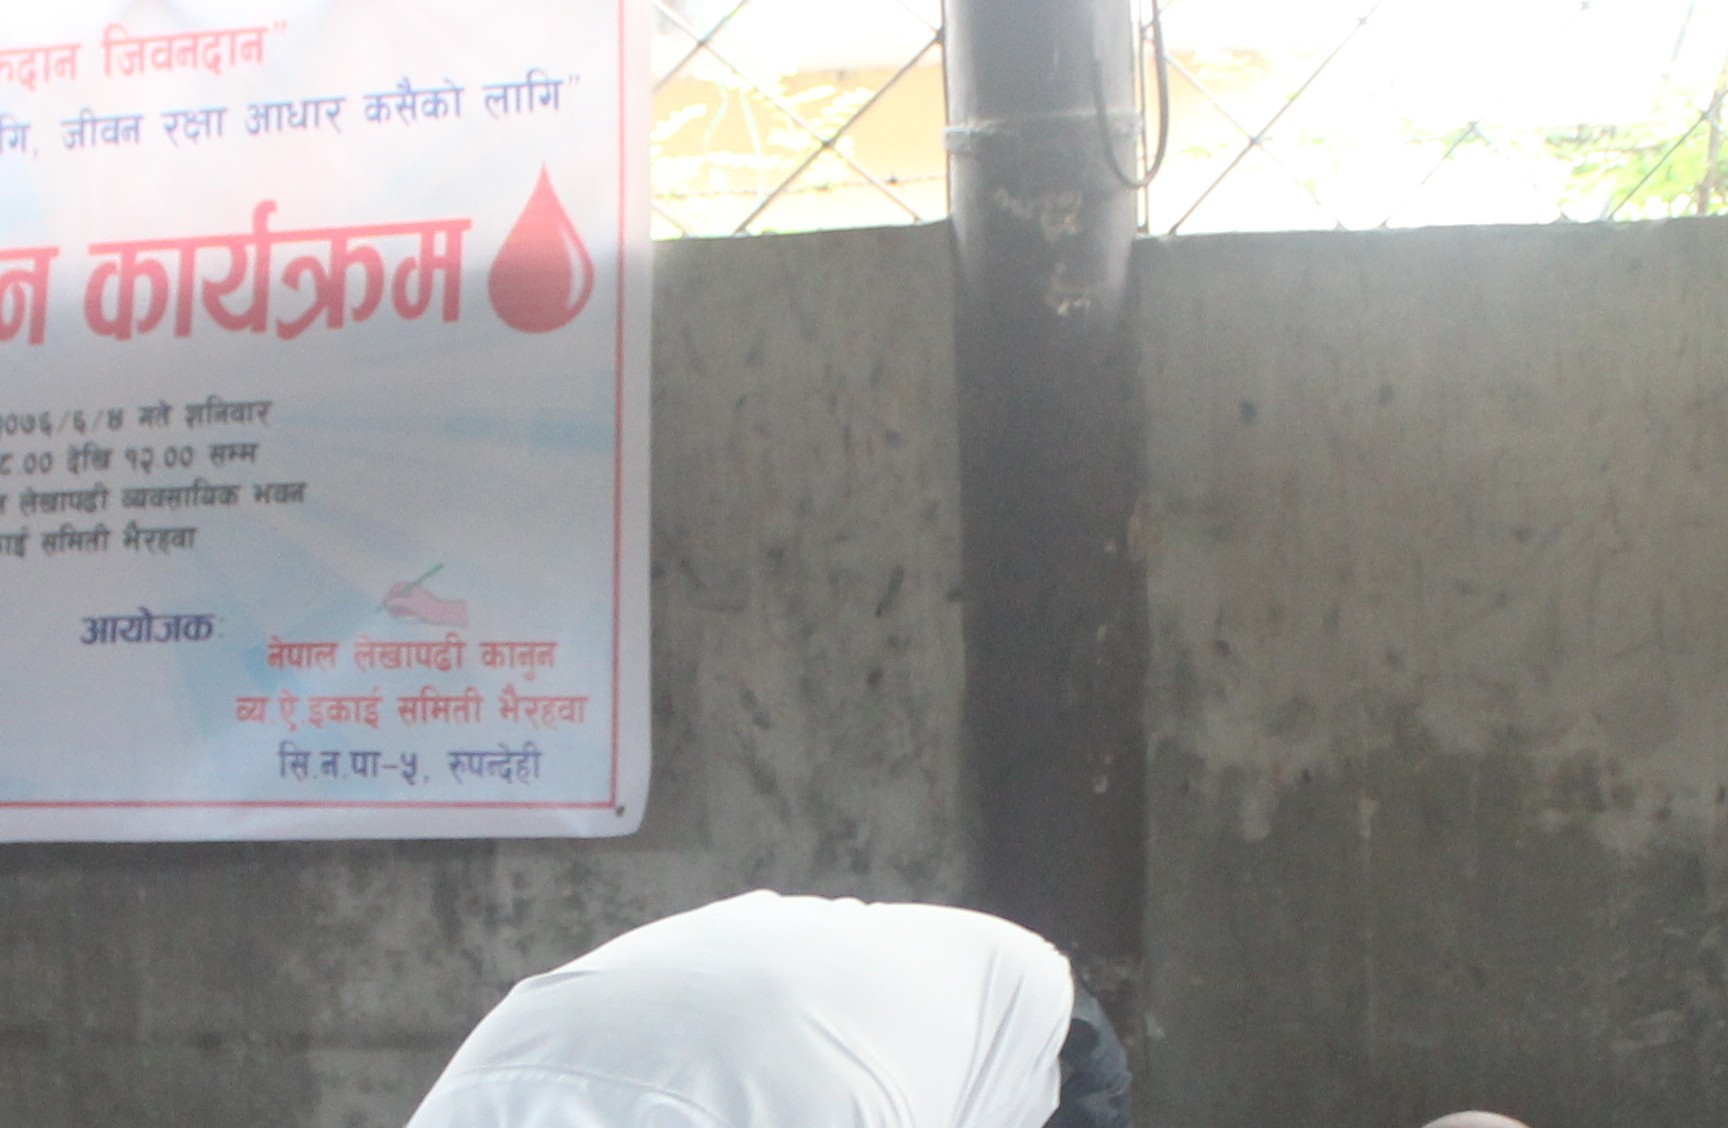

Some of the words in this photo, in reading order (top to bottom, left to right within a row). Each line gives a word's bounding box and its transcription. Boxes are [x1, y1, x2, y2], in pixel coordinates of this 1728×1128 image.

[60, 108, 143, 149] जीवन
[162, 108, 228, 146] रक्षा
[244, 97, 345, 135] आधार
[363, 76, 465, 126] कसैको
[82, 201, 471, 341] कार्यक्रम
[209, 442, 258, 466] सम्म
[254, 482, 306, 505] भवन
[266, 635, 339, 671] नेपाल
[499, 684, 589, 730] भैरहवा
